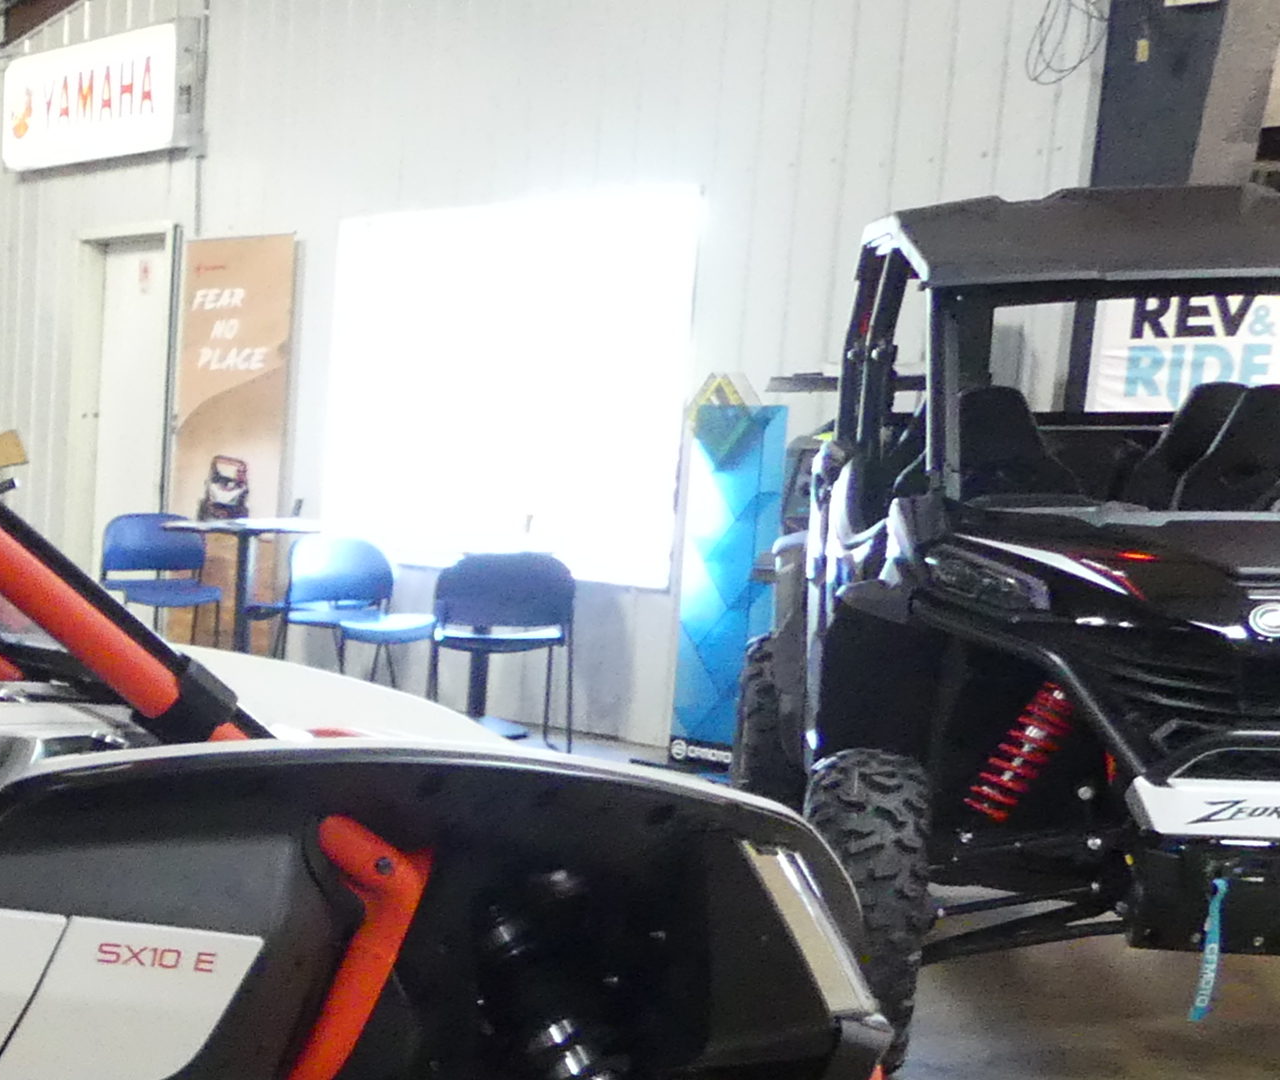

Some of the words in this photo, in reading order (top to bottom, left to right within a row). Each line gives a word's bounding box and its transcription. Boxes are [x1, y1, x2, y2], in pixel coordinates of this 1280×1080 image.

[43, 55, 155, 129] YAMAHA
[192, 287, 245, 311] FEAR
[210, 318, 239, 340] NO
[1130, 295, 1256, 339] REV
[1248, 304, 1276, 337] &
[197, 346, 268, 371] PLACE
[1124, 343, 1272, 409] RIDE
[97, 941, 181, 971] SX10
[195, 951, 217, 974] E
